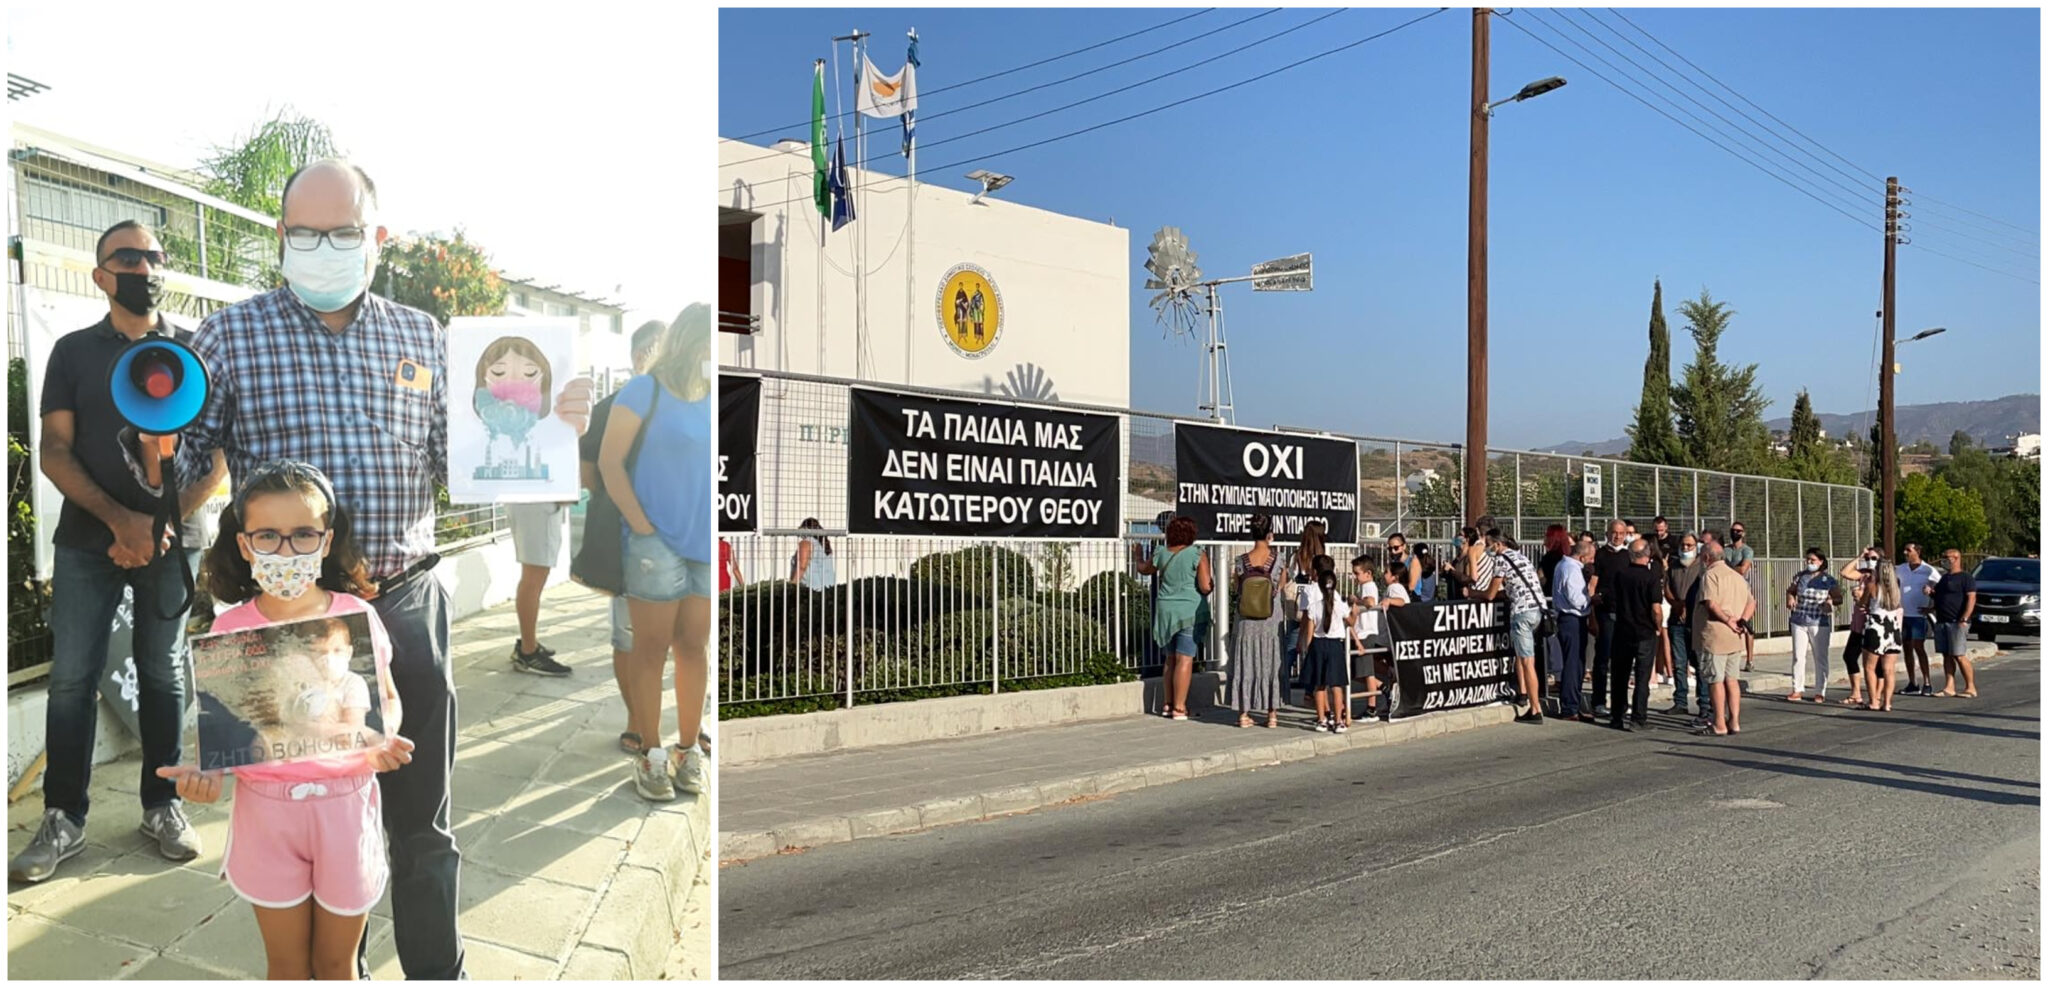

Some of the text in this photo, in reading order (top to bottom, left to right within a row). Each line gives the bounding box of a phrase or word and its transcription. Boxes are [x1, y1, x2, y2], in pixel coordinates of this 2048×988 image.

[902, 408, 1083, 450] ΤΑ ΠΑΙΔΙΑ ΜΑΣ
[881, 449, 1097, 488] ΔΕΝ ΕΙΝΑΙ ΠΑΙΔΙΑ
[1242, 441, 1304, 480] ΟΧΙ
[874, 490, 1103, 525] ΚΑΤΩΤΕΡΟΥ ΘΕΟΥ
[1179, 482, 1355, 511] ΣΤΗΝ ΣΥΜΠΛΕΓΜΑΤΟΠΟΙΗΣΗ ΤΑΞΕΩΝ
[1433, 602, 1505, 632] ΖΗΤΑΜΕ
[1395, 639, 1422, 661] ΙΣΕΣ
[1423, 634, 1484, 658] ΕΥΚΑΙΡΙΕΣ
[1422, 663, 1441, 685] ΙΣΗ
[1422, 690, 1444, 710] ΙΣΑ
